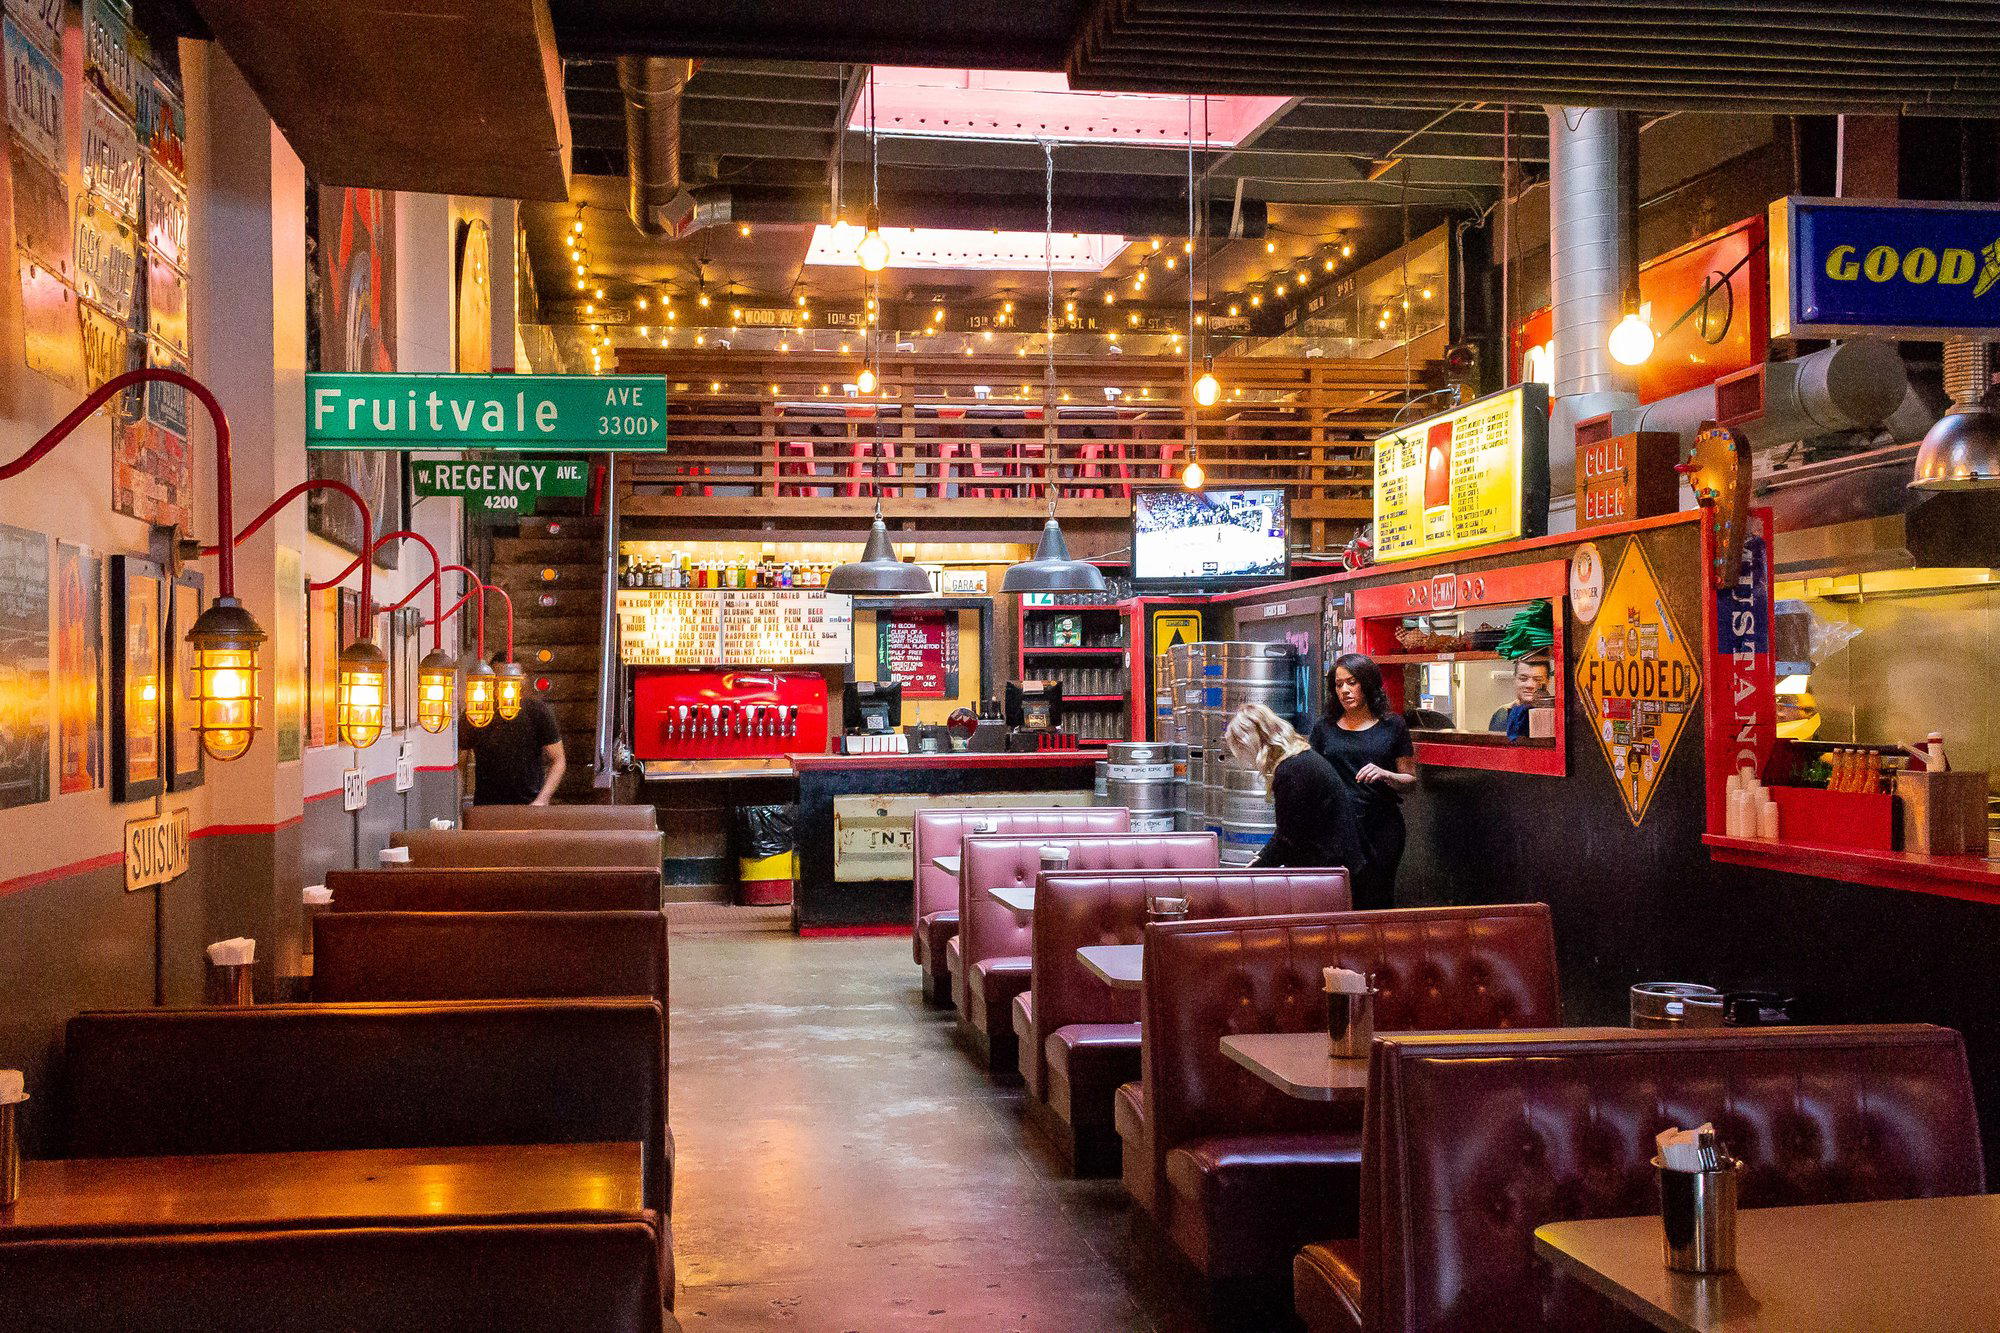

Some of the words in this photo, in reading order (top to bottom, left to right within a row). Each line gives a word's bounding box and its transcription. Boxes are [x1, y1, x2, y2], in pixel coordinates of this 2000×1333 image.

[1826, 245, 1976, 284] GOOD
[314, 389, 559, 432] Fruitvale
[605, 387, 643, 406] AVE
[598, 417, 648, 435] 3300
[418, 470, 431, 484] W.
[435, 465, 546, 491] REGENCY
[556, 466, 581, 480] AVE.
[484, 496, 518, 509] 4200
[952, 579, 985, 591] GARAE
[695, 600, 719, 608] PORTER
[1589, 660, 1685, 697] FLOODED
